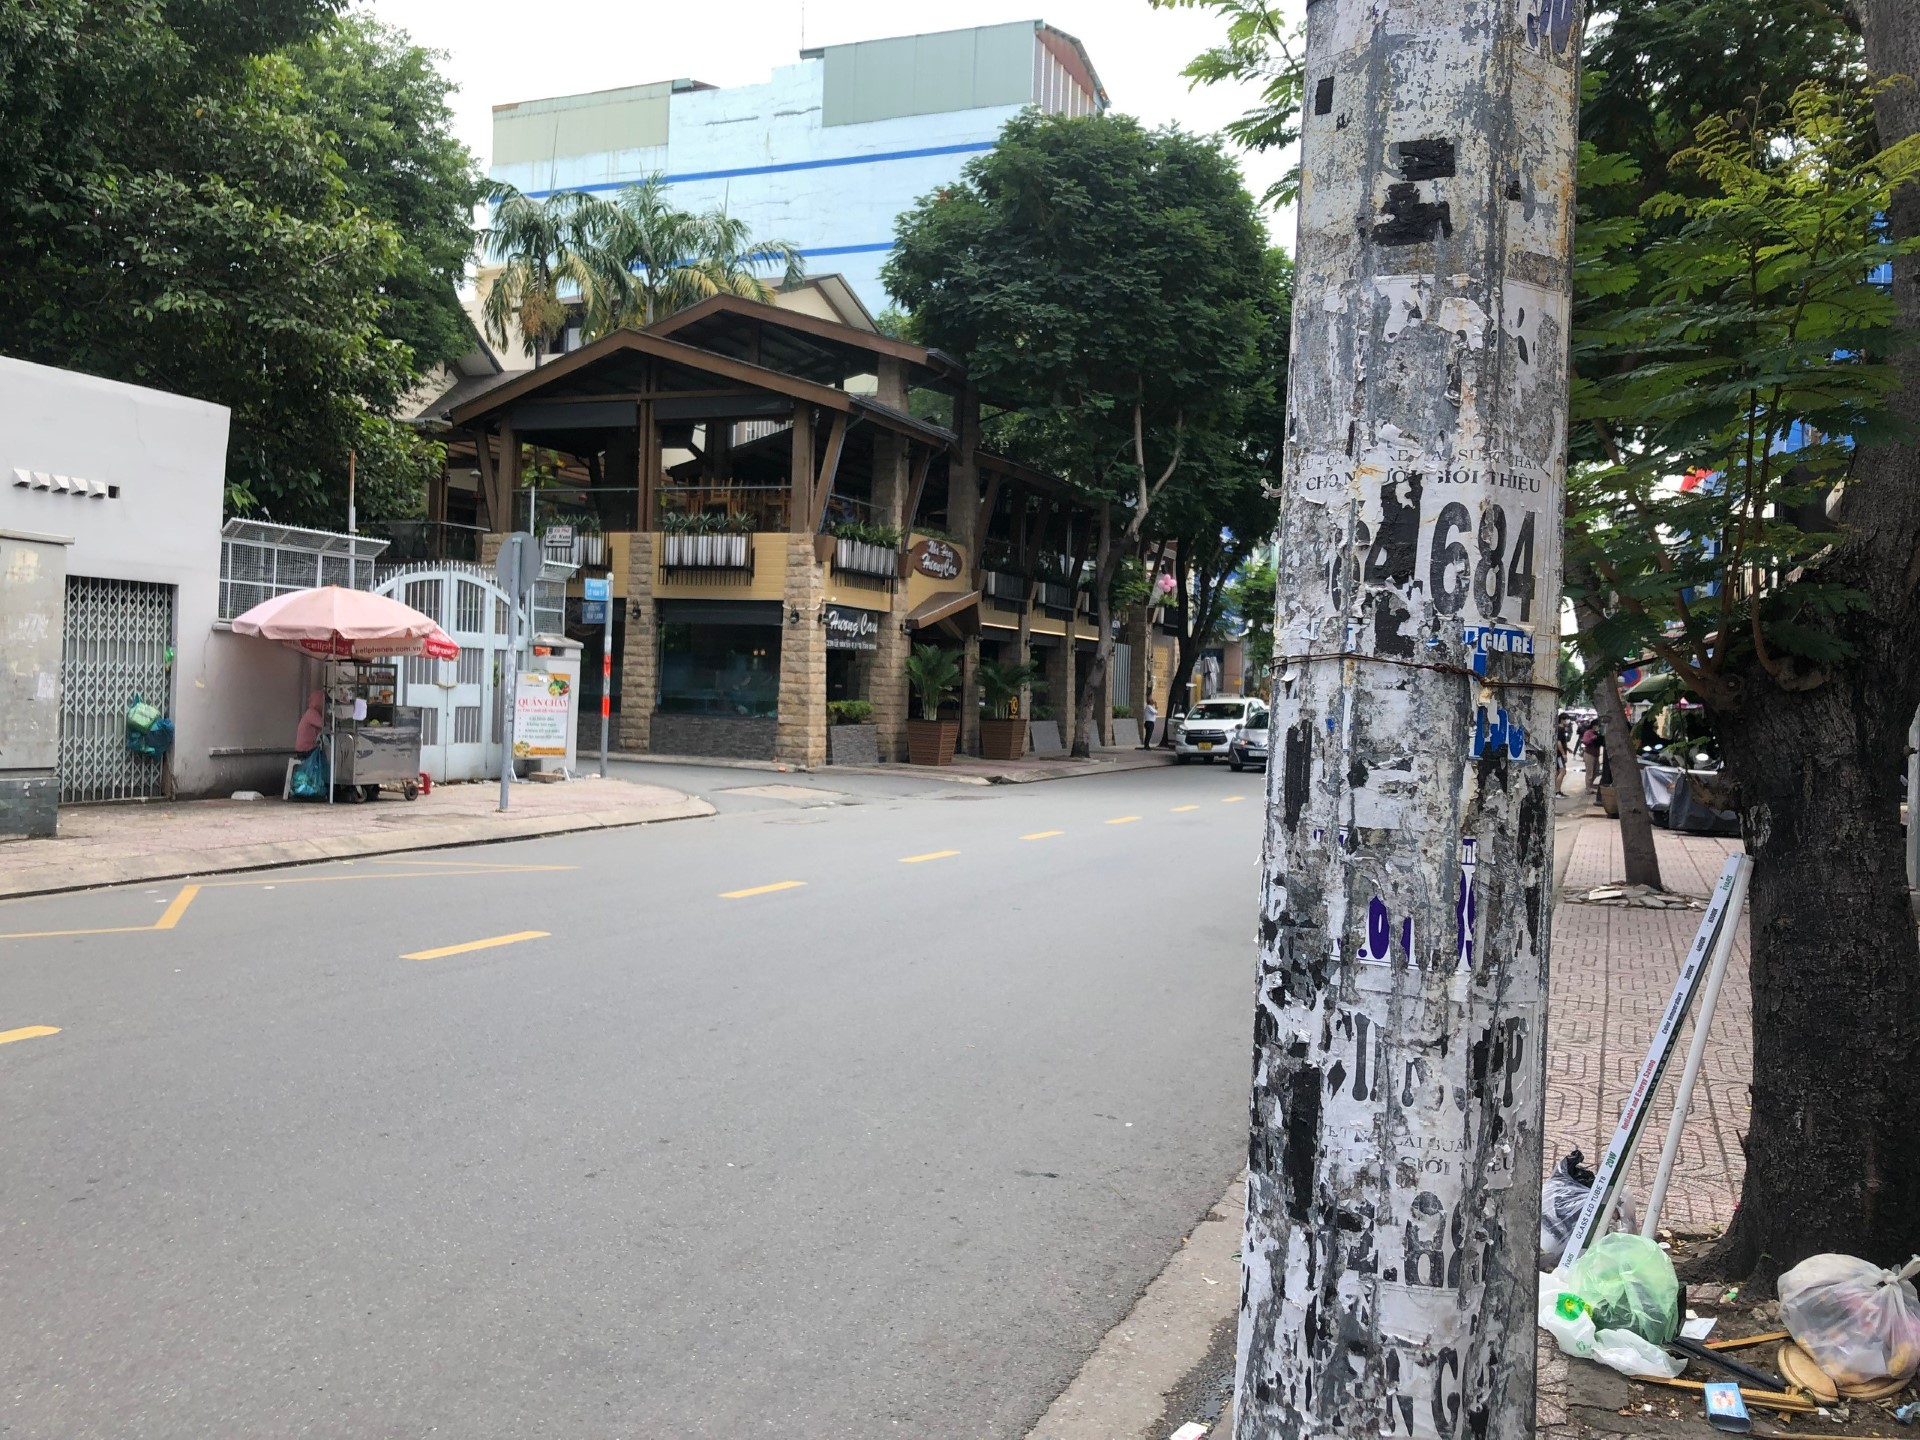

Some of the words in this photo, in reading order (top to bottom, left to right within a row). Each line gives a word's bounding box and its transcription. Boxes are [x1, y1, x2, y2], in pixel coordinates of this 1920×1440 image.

[1487, 472, 1541, 493] THIỆU
[828, 610, 859, 638] Hương
[860, 613, 878, 636] Cau
[1480, 631, 1508, 652] GIÁ
[1661, 1019, 1671, 1034] Color
[1668, 992, 1684, 1021] temperature
[1621, 1107, 1635, 1130] Reliable
[1631, 1097, 1640, 1108] and
[1636, 1077, 1649, 1097] Energy
[1643, 1059, 1656, 1079] Saving
[1605, 1150, 1617, 1168] 20W
[1576, 1217, 1589, 1240] GLASS
[1585, 1202, 1595, 1217] LED
[1592, 1184, 1603, 1203] TUBE
[1599, 1175, 1607, 1185] T8
